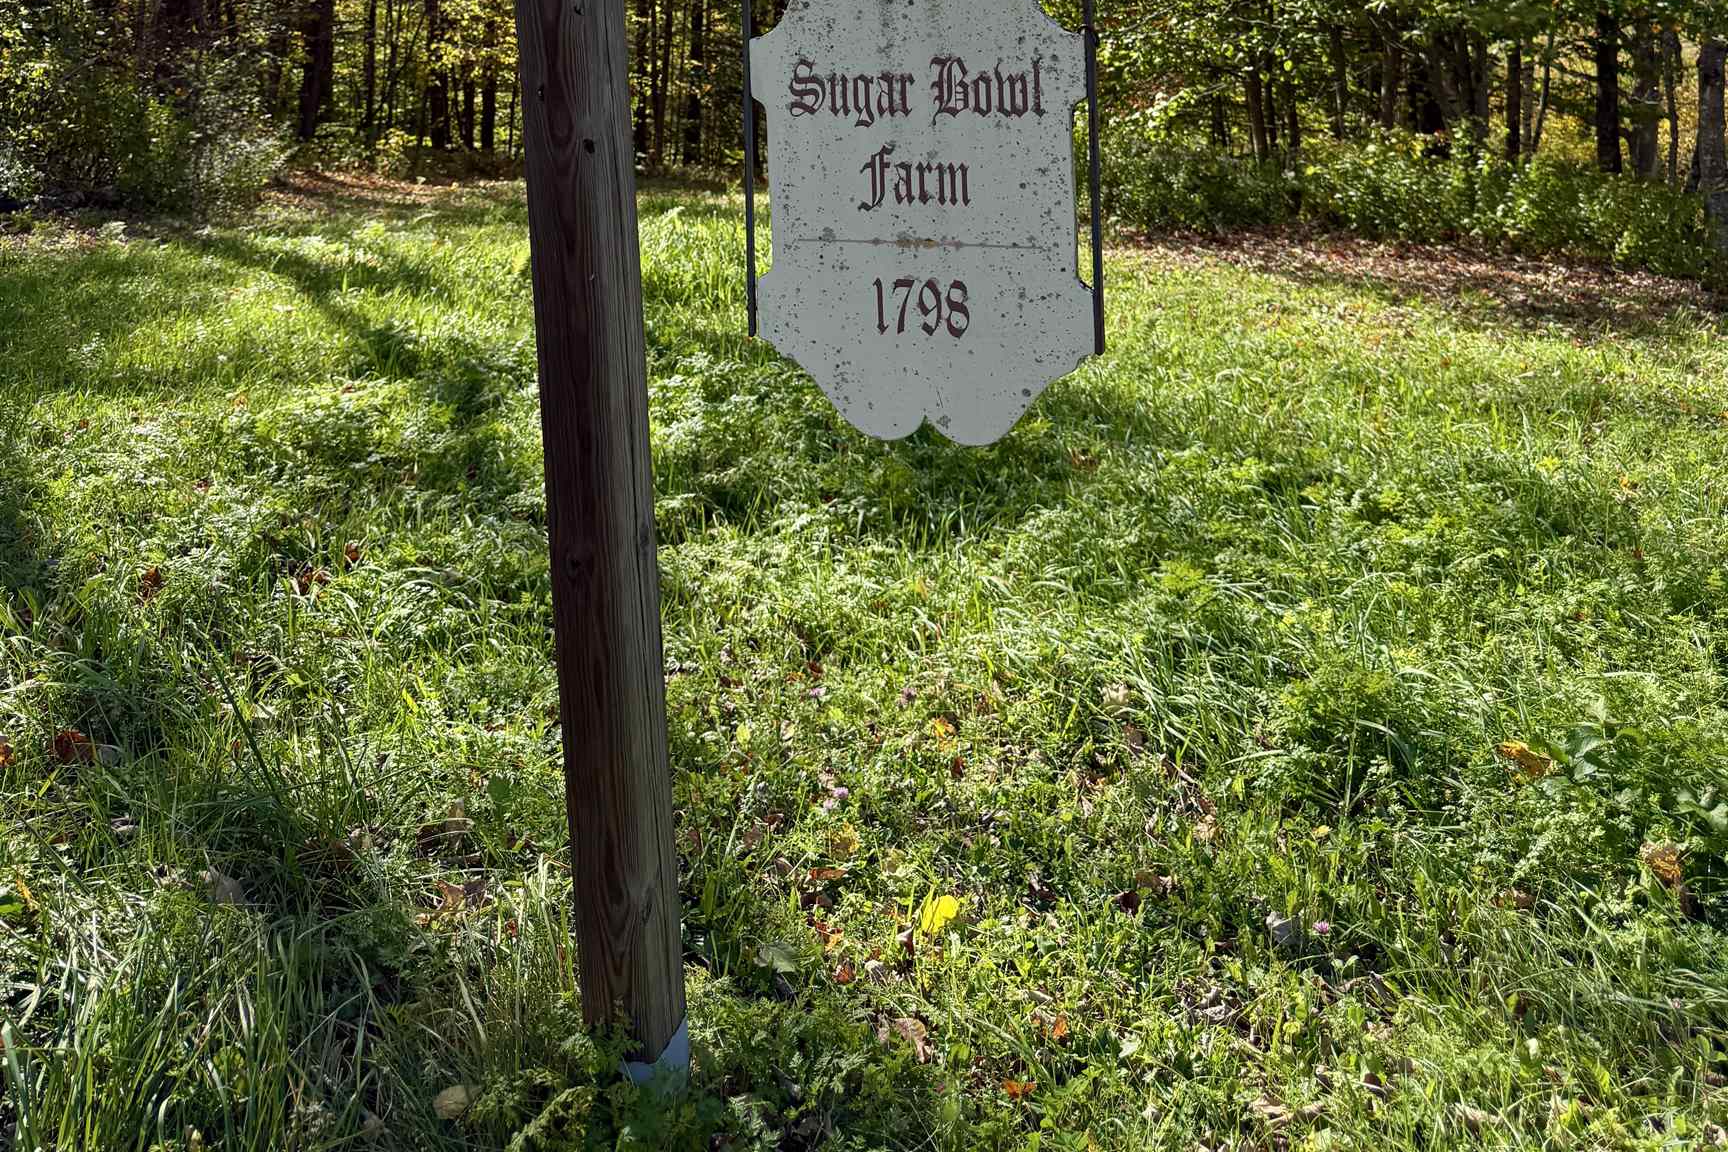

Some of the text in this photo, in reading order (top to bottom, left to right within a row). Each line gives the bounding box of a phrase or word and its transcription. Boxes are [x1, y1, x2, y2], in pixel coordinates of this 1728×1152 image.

[789, 55, 1046, 127] Sugar Bowl
[873, 278, 970, 338] 1798
